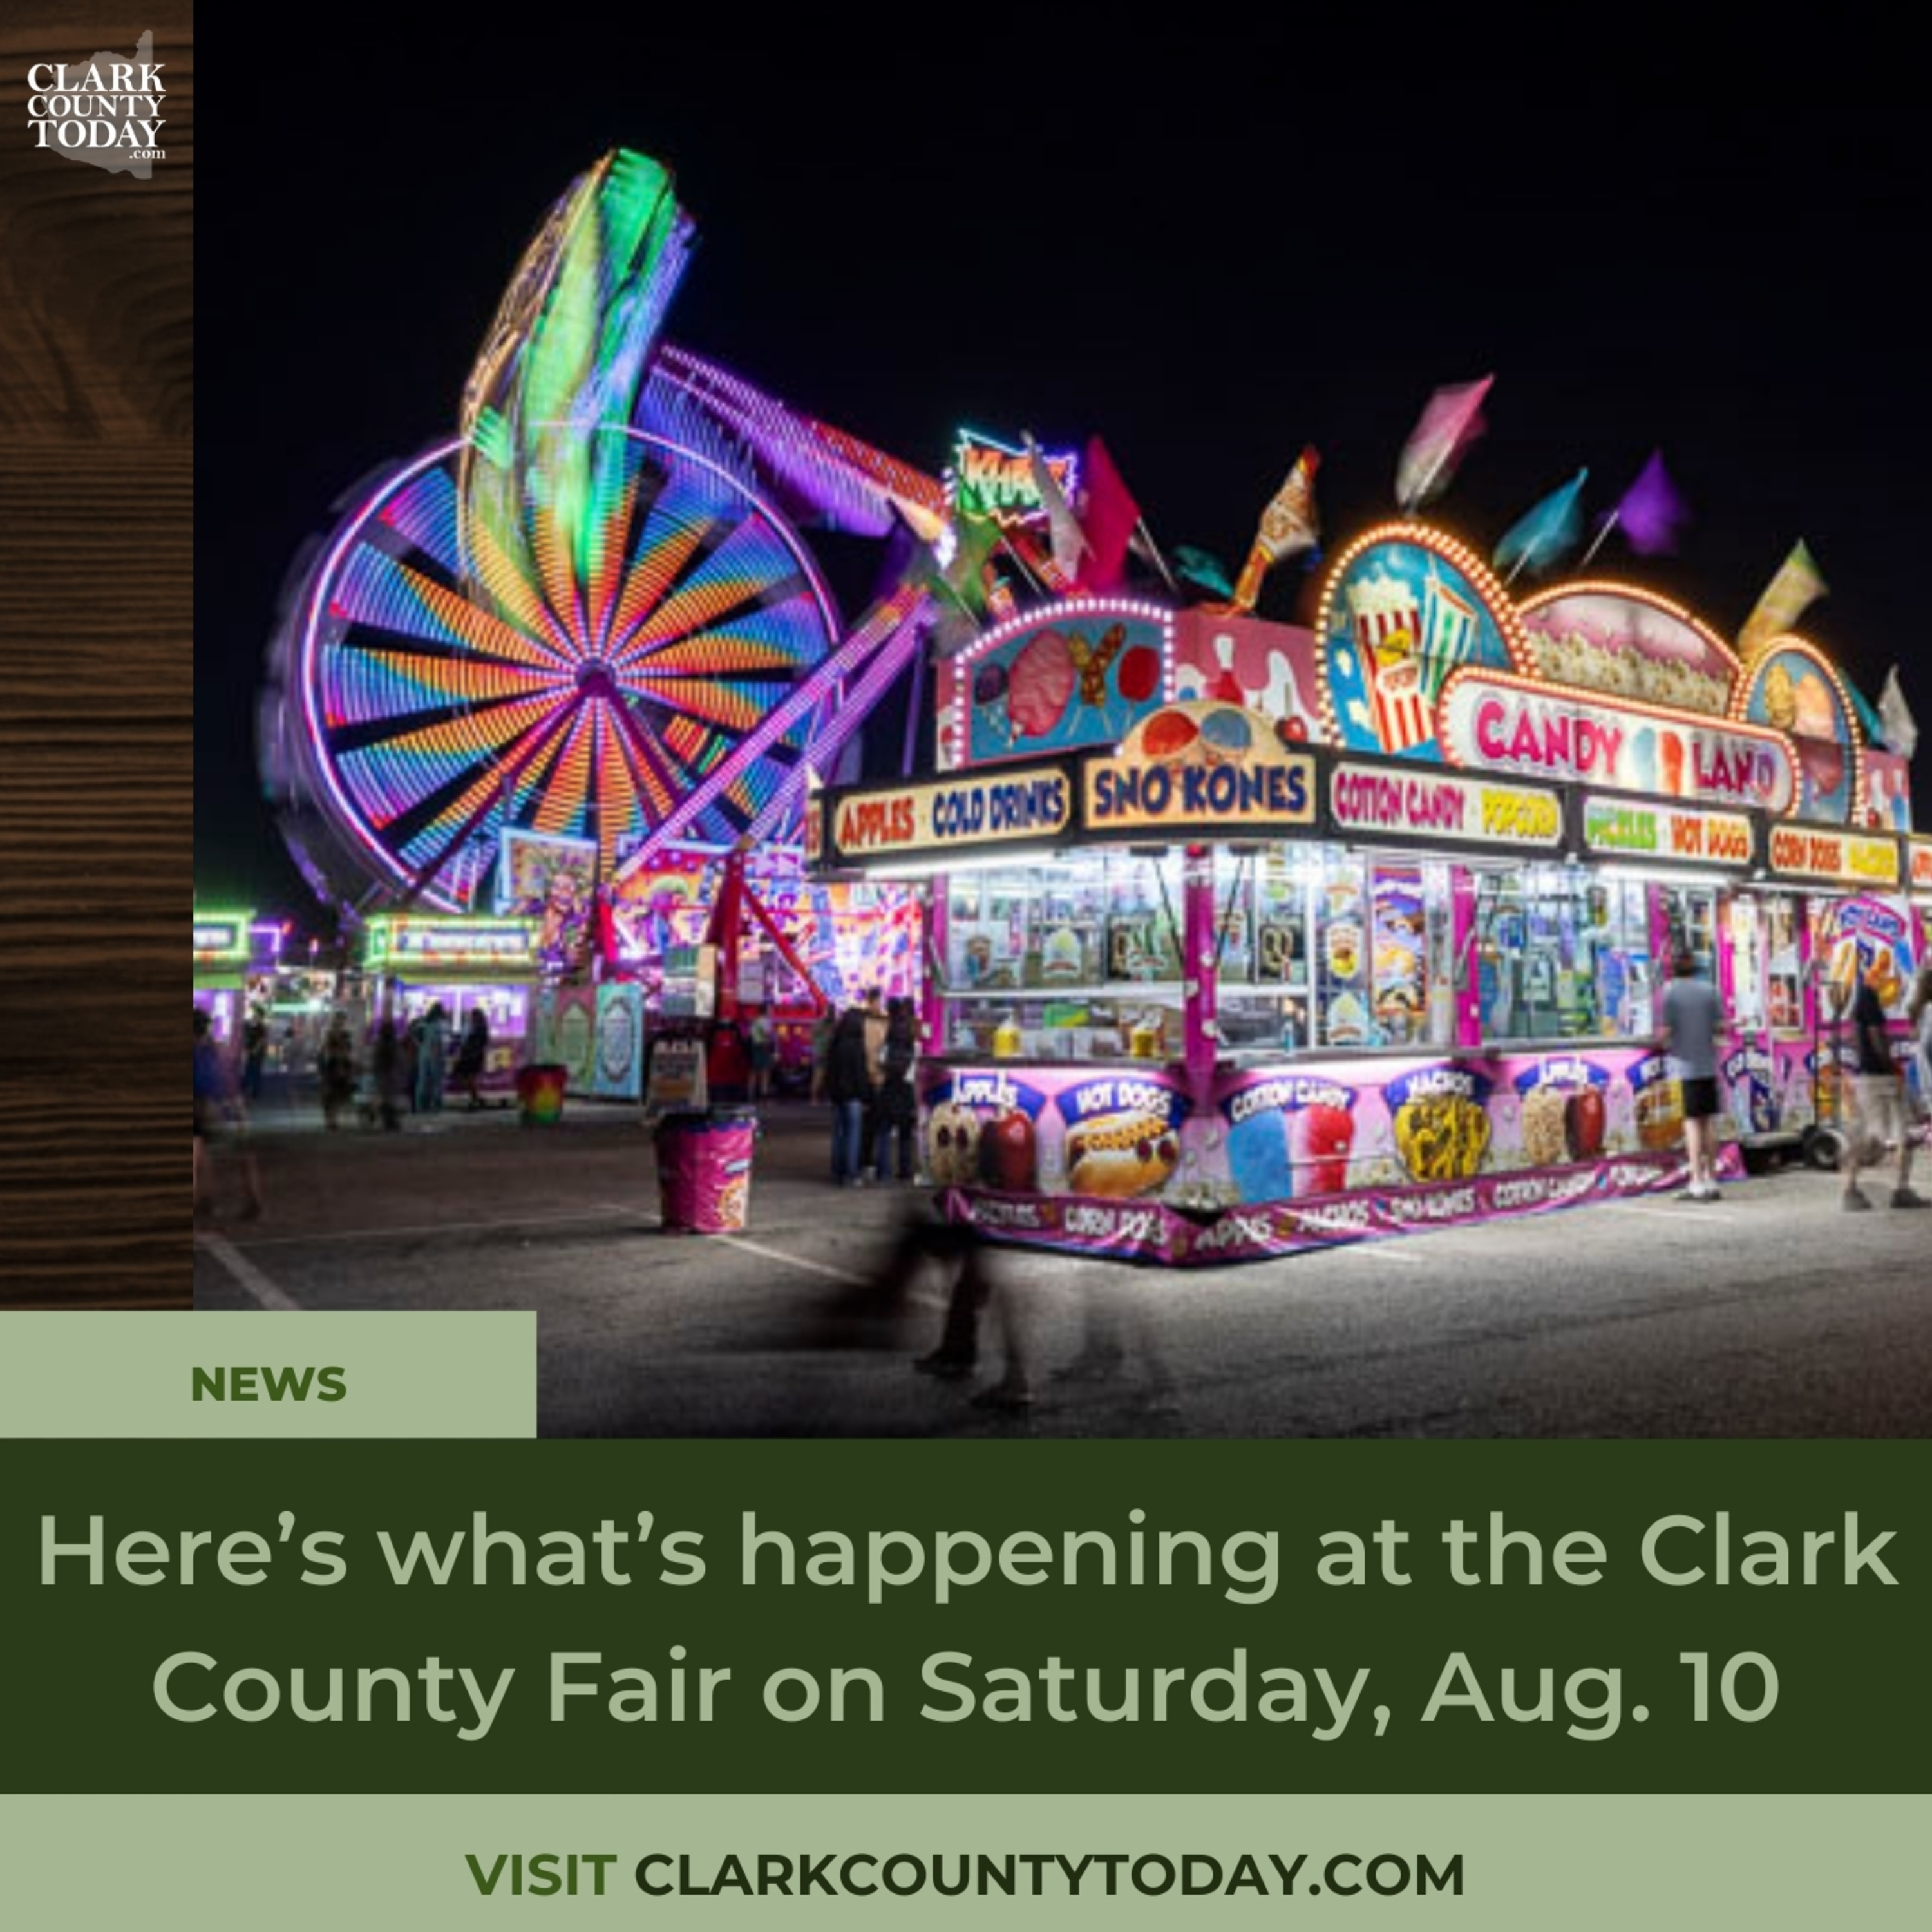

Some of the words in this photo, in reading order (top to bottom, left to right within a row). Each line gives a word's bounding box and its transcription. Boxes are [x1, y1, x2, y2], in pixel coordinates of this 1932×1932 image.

[1476, 701, 1622, 773] CANDY
[1693, 741, 1775, 797] LAND
[841, 796, 914, 848] APPLES
[933, 788, 983, 838] COLD
[989, 777, 1063, 831] DRINKS
[1095, 768, 1171, 816] SNO
[1184, 765, 1306, 813] KONES
[1334, 772, 1404, 826] COTTON
[1405, 779, 1464, 831] CANDY
[1670, 814, 1702, 854] HOT
[1076, 1084, 1113, 1114] HOT
[1116, 1082, 1173, 1117] DOGS
